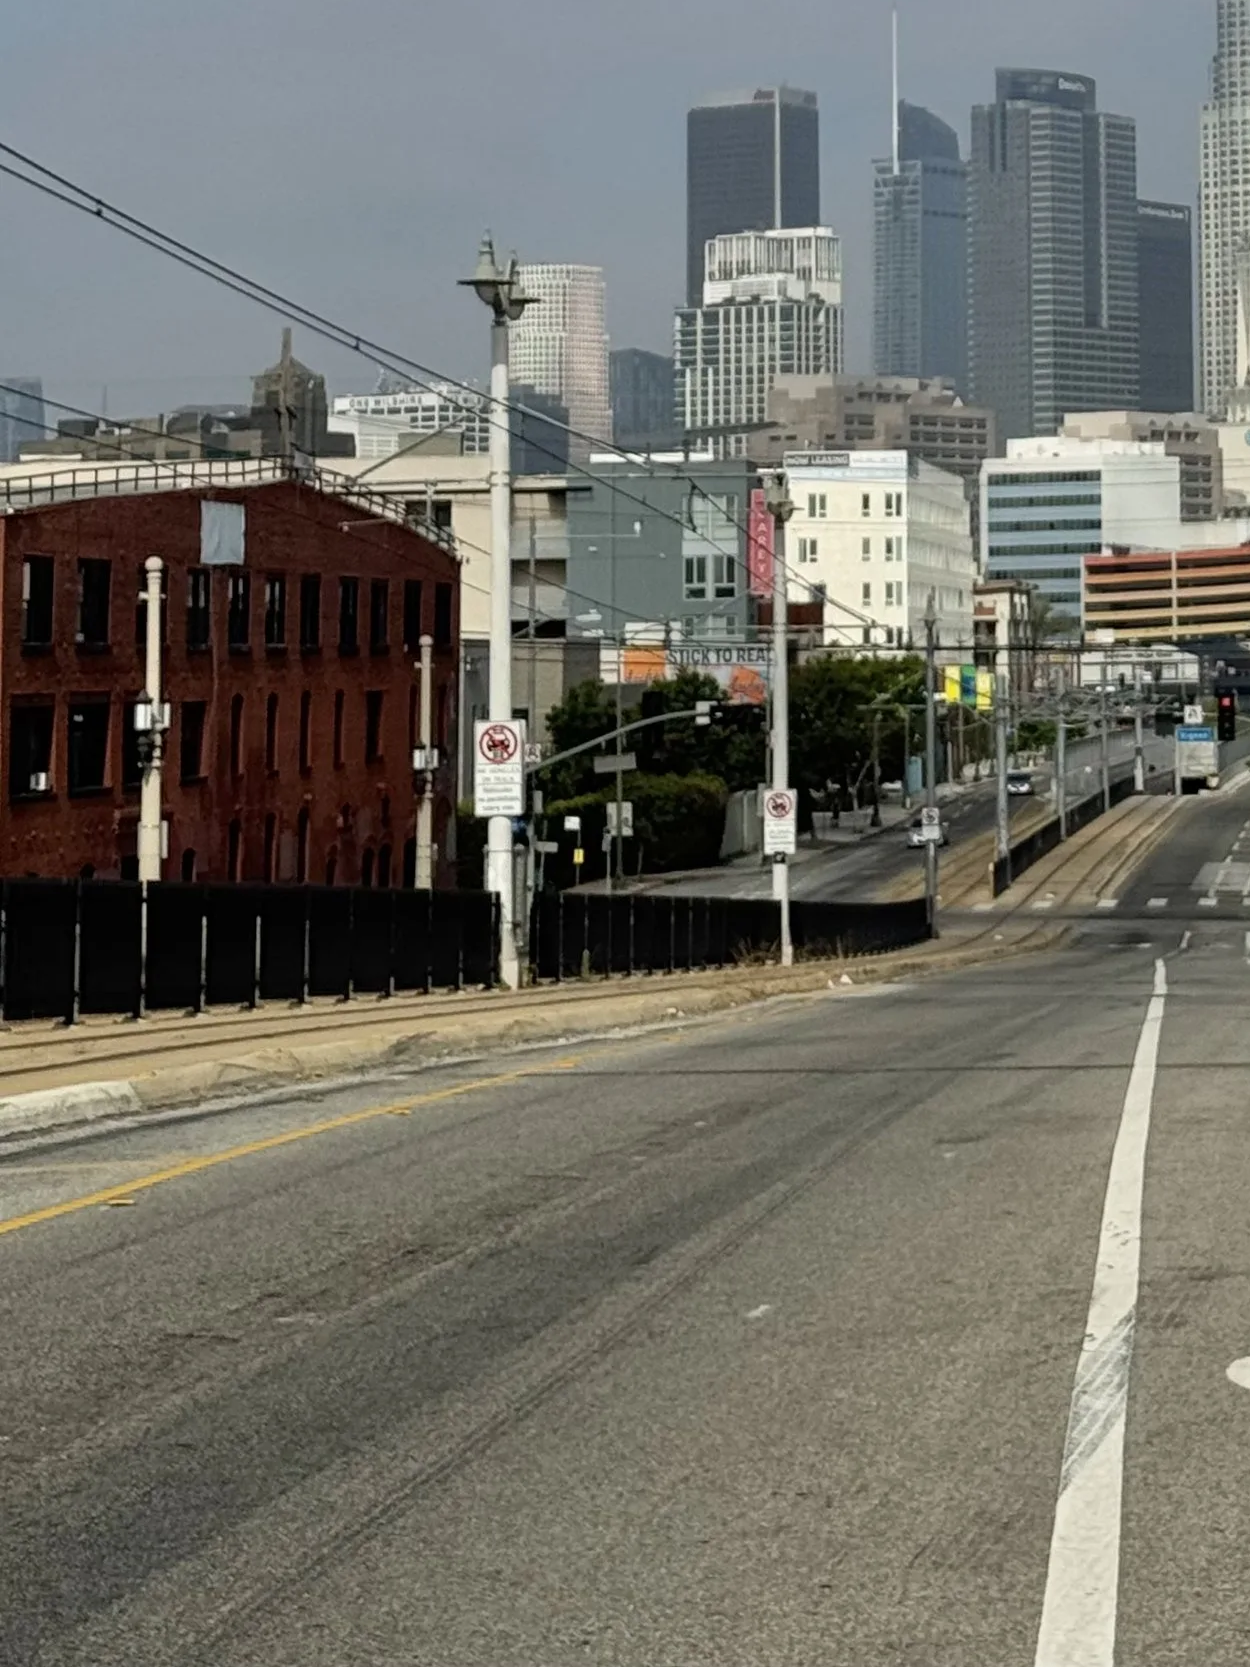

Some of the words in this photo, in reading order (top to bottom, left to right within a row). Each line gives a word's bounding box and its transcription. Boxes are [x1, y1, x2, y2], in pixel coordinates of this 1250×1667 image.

[350, 397, 369, 408] ONE
[374, 396, 422, 407] WILSHIRE
[667, 648, 711, 665] STICK
[715, 648, 733, 664] TO
